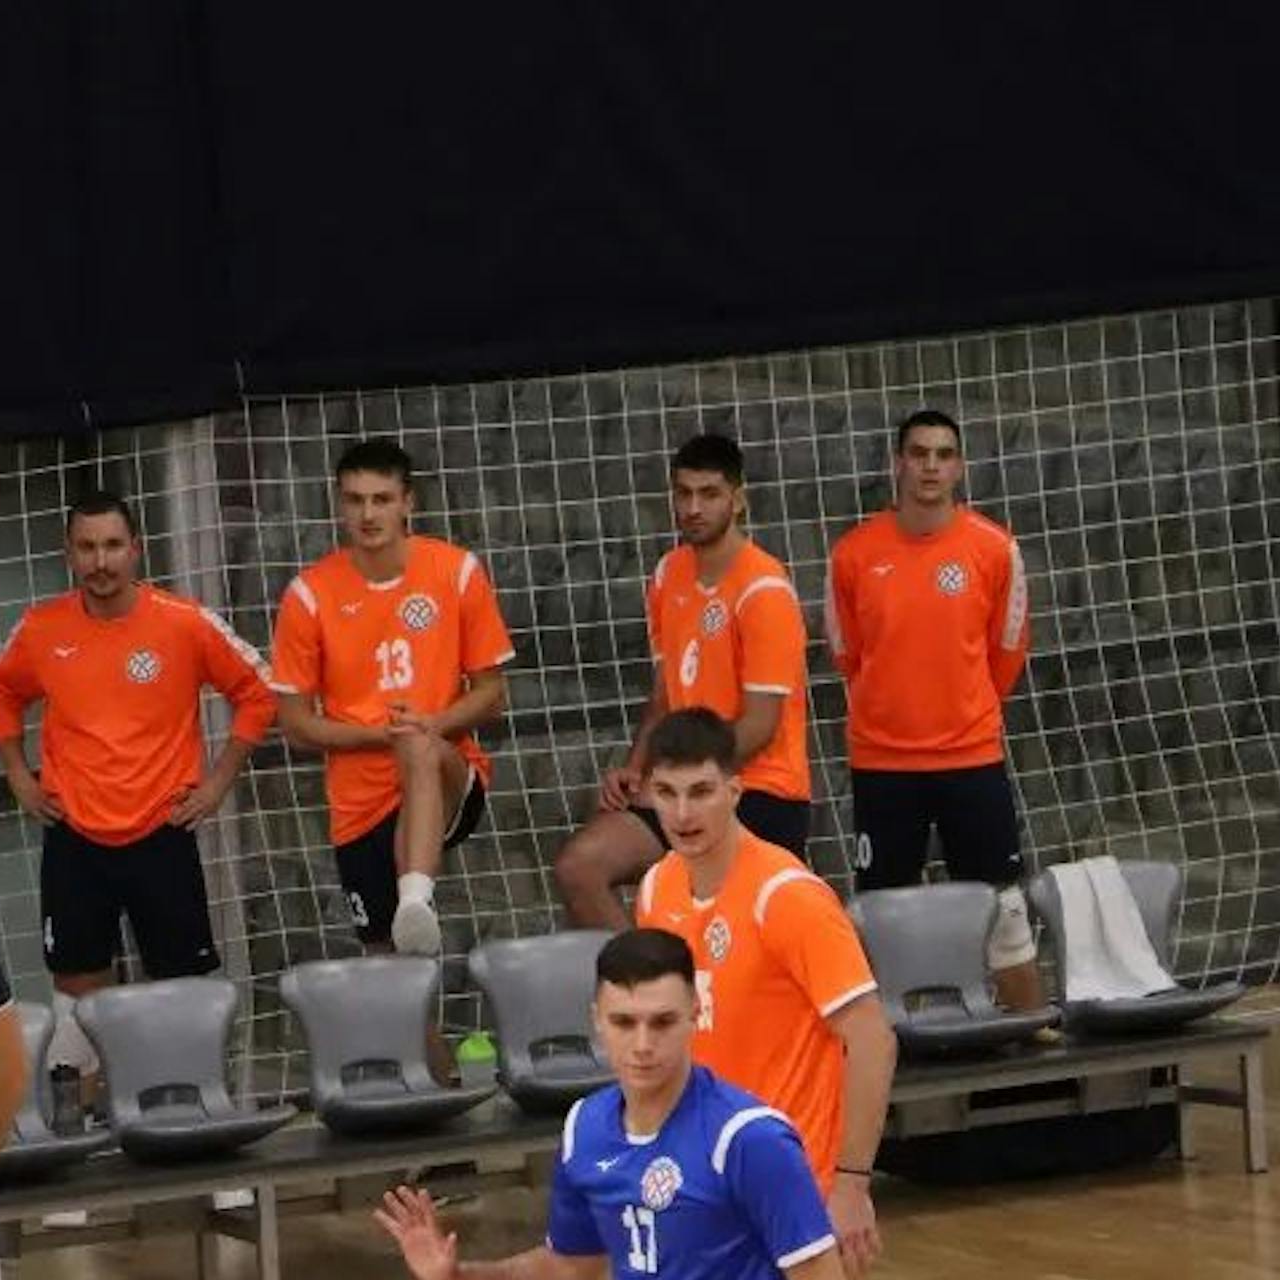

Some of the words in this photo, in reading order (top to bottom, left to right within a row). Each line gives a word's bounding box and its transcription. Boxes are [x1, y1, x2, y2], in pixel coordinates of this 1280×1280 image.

[374, 639, 414, 690] 13
[679, 639, 699, 688] 6
[621, 1203, 658, 1275] 17
